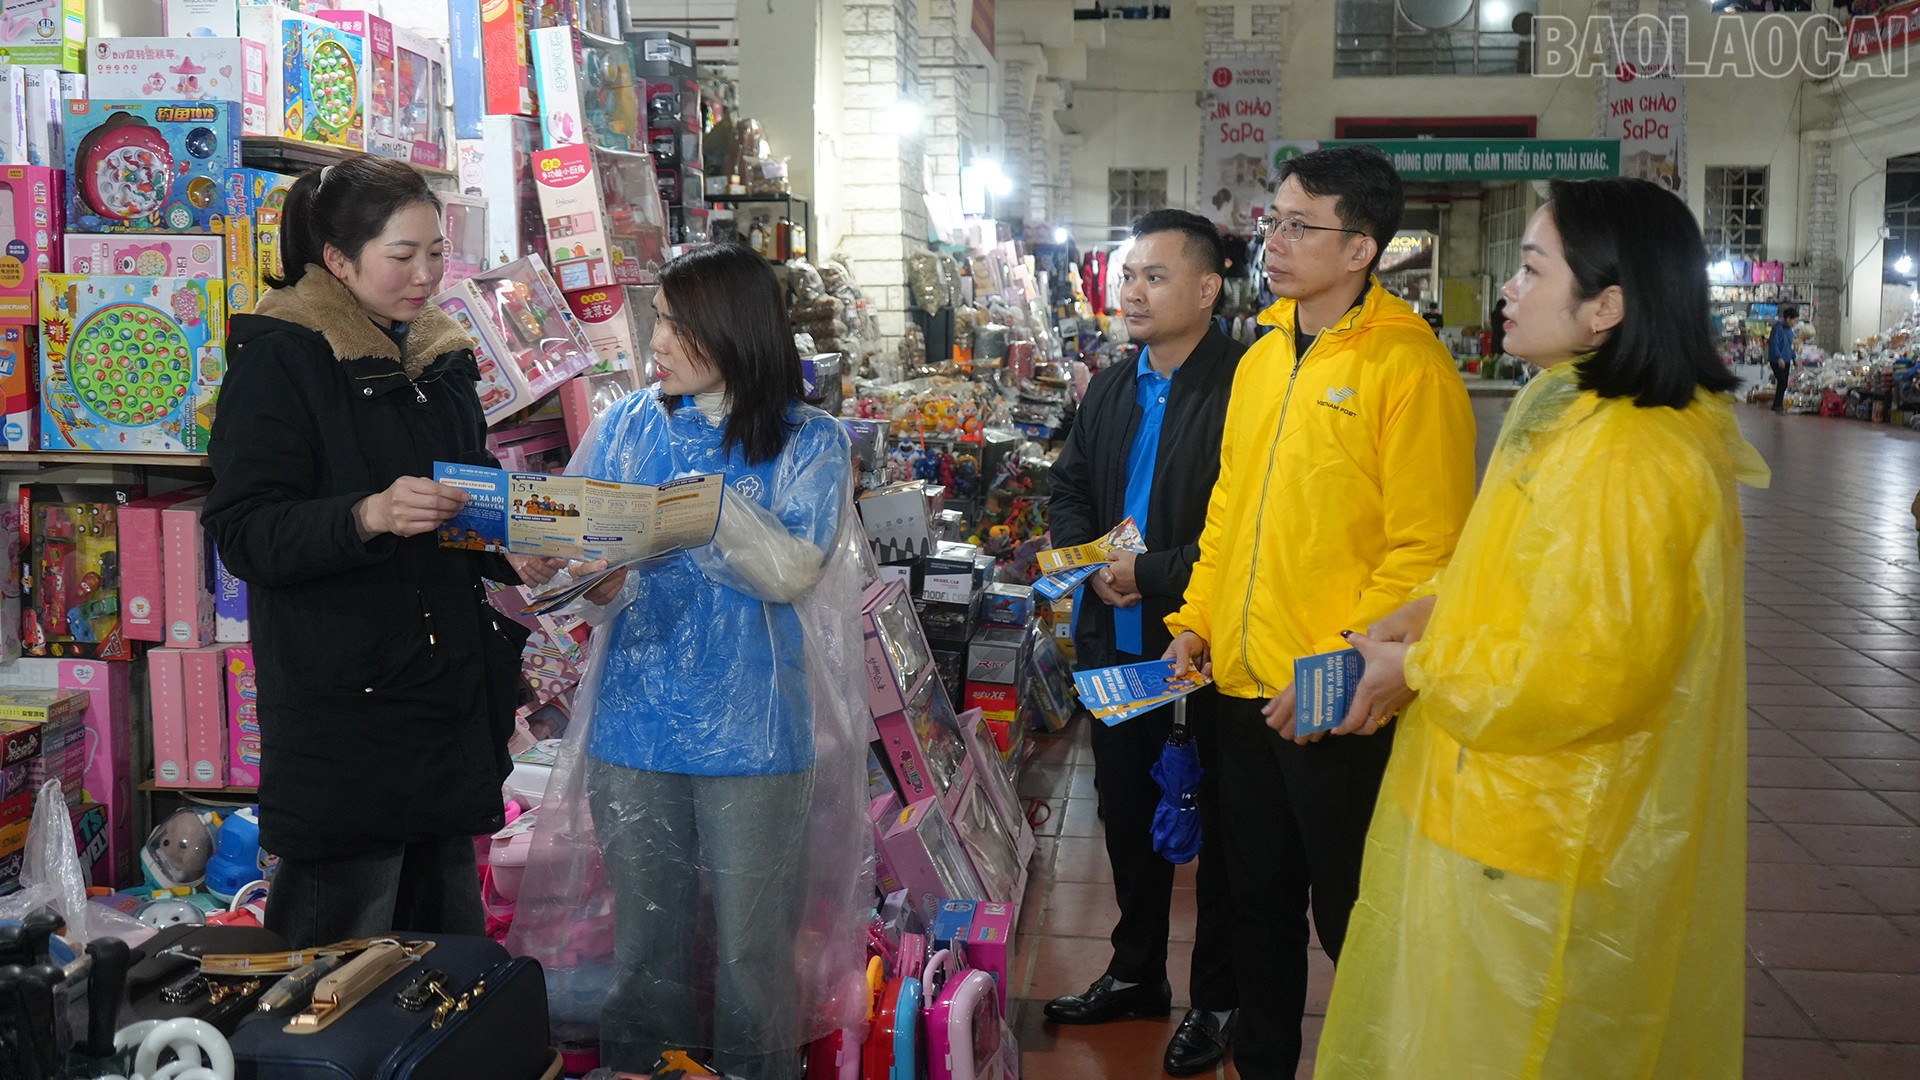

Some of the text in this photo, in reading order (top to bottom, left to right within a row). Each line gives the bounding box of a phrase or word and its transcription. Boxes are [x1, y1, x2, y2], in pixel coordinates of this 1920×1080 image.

[1235, 96, 1272, 117] CHÀO
[1610, 91, 1677, 117] XIN CHÀO
[1220, 121, 1265, 143] SaPa
[1622, 117, 1669, 140] SaPa
[1423, 152, 1442, 170] QUY
[1445, 152, 1472, 174] ĐỊNH,
[1474, 147, 1500, 170] GIẢM
[1502, 145, 1531, 170] THIỂU
[1532, 149, 1552, 170] RÁC
[1556, 147, 1577, 170] THẢI
[1579, 149, 1609, 170] KHÁC.
[7, 330, 18, 340] 3+
[1317, 400, 1357, 418] VIETNAM POST
[512, 482, 526, 492] 15
[76, 668, 91, 676] 3+
[1327, 656, 1336, 670] HỘI
[1336, 655, 1344, 687] NGUYỆN
[1325, 684, 1334, 705] HIỂM
[1325, 706, 1334, 722] BẢO
